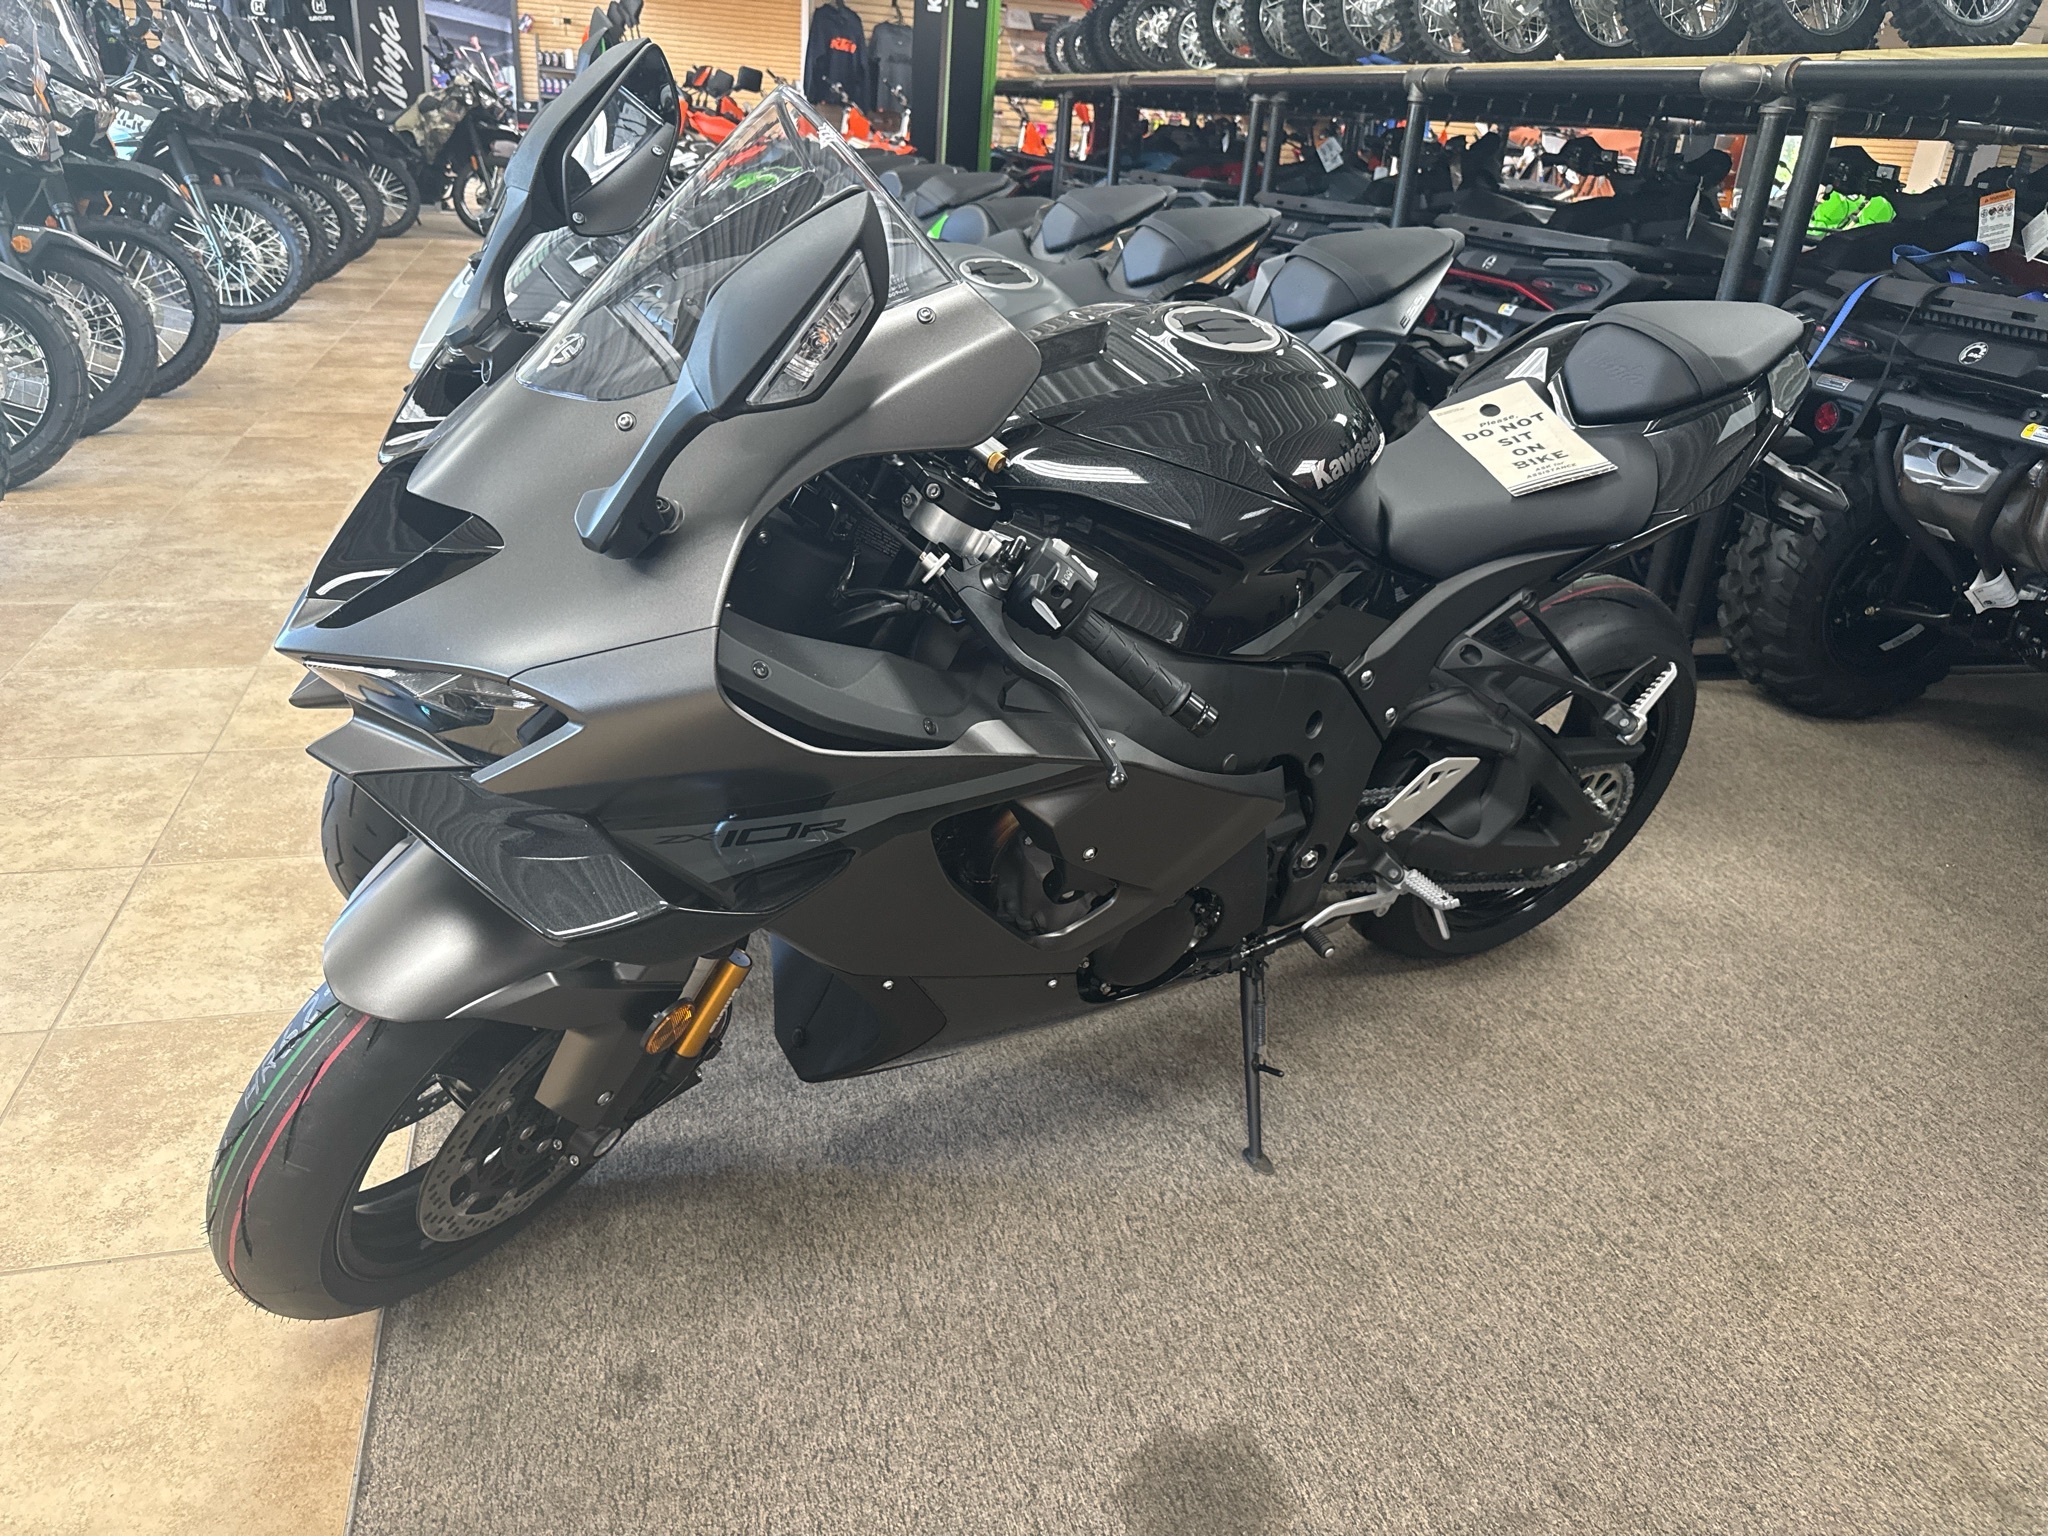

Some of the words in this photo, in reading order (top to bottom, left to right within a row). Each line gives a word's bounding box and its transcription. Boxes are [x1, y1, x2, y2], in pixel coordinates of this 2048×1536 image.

[370, 6, 414, 109] Ninja
[1462, 427, 1494, 442] DO
[1500, 412, 1545, 433] NOT
[1479, 414, 1519, 428] Please,
[1498, 431, 1533, 447] SIT
[1512, 442, 1546, 456] ON
[1511, 450, 1569, 470] BIKE
[1526, 462, 1577, 480] ASSISTANCE
